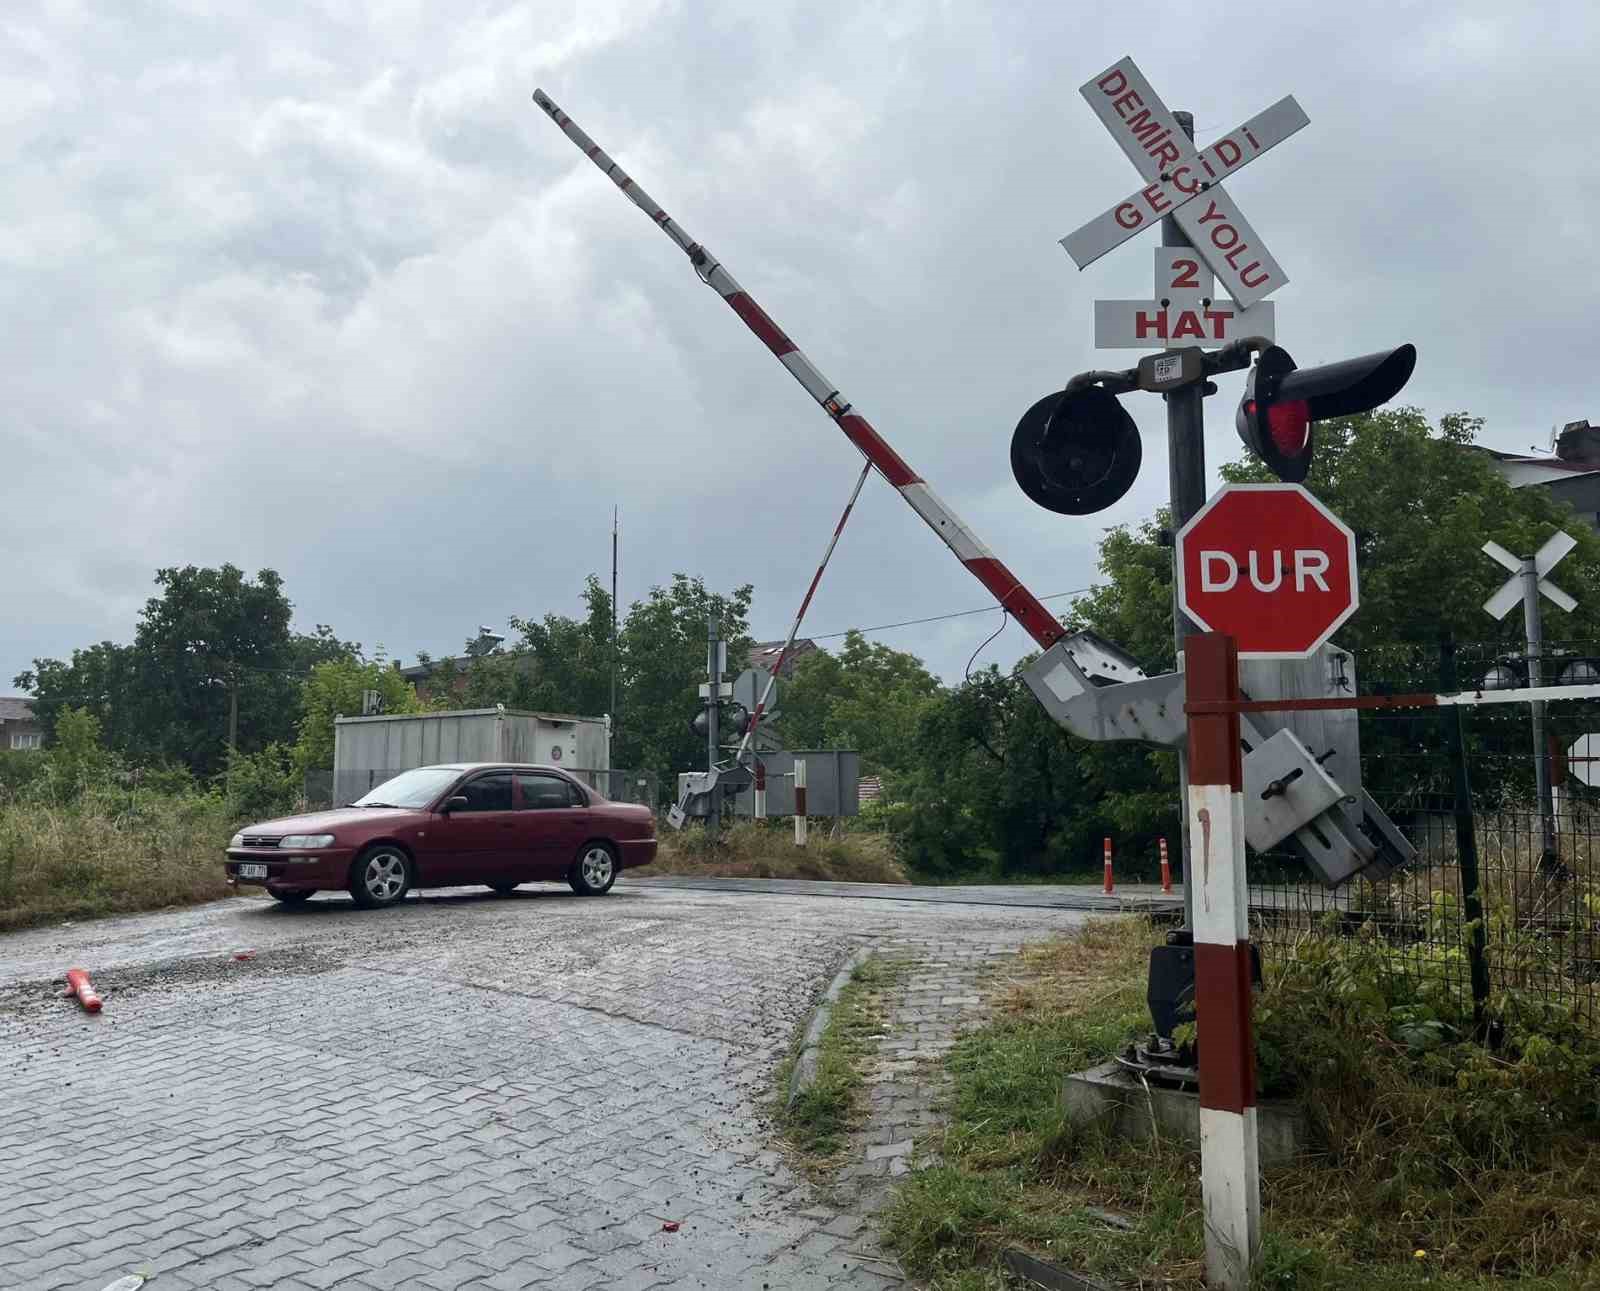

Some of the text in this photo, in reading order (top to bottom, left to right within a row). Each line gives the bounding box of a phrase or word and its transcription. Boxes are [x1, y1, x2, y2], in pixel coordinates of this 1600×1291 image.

[1097, 69, 1270, 288] DEMİR YOLU
[1114, 127, 1260, 230] GEÇİDİ
[1170, 259, 1200, 288] 2
[1135, 311, 1235, 339] HAT
[1200, 550, 1331, 592] DUR
